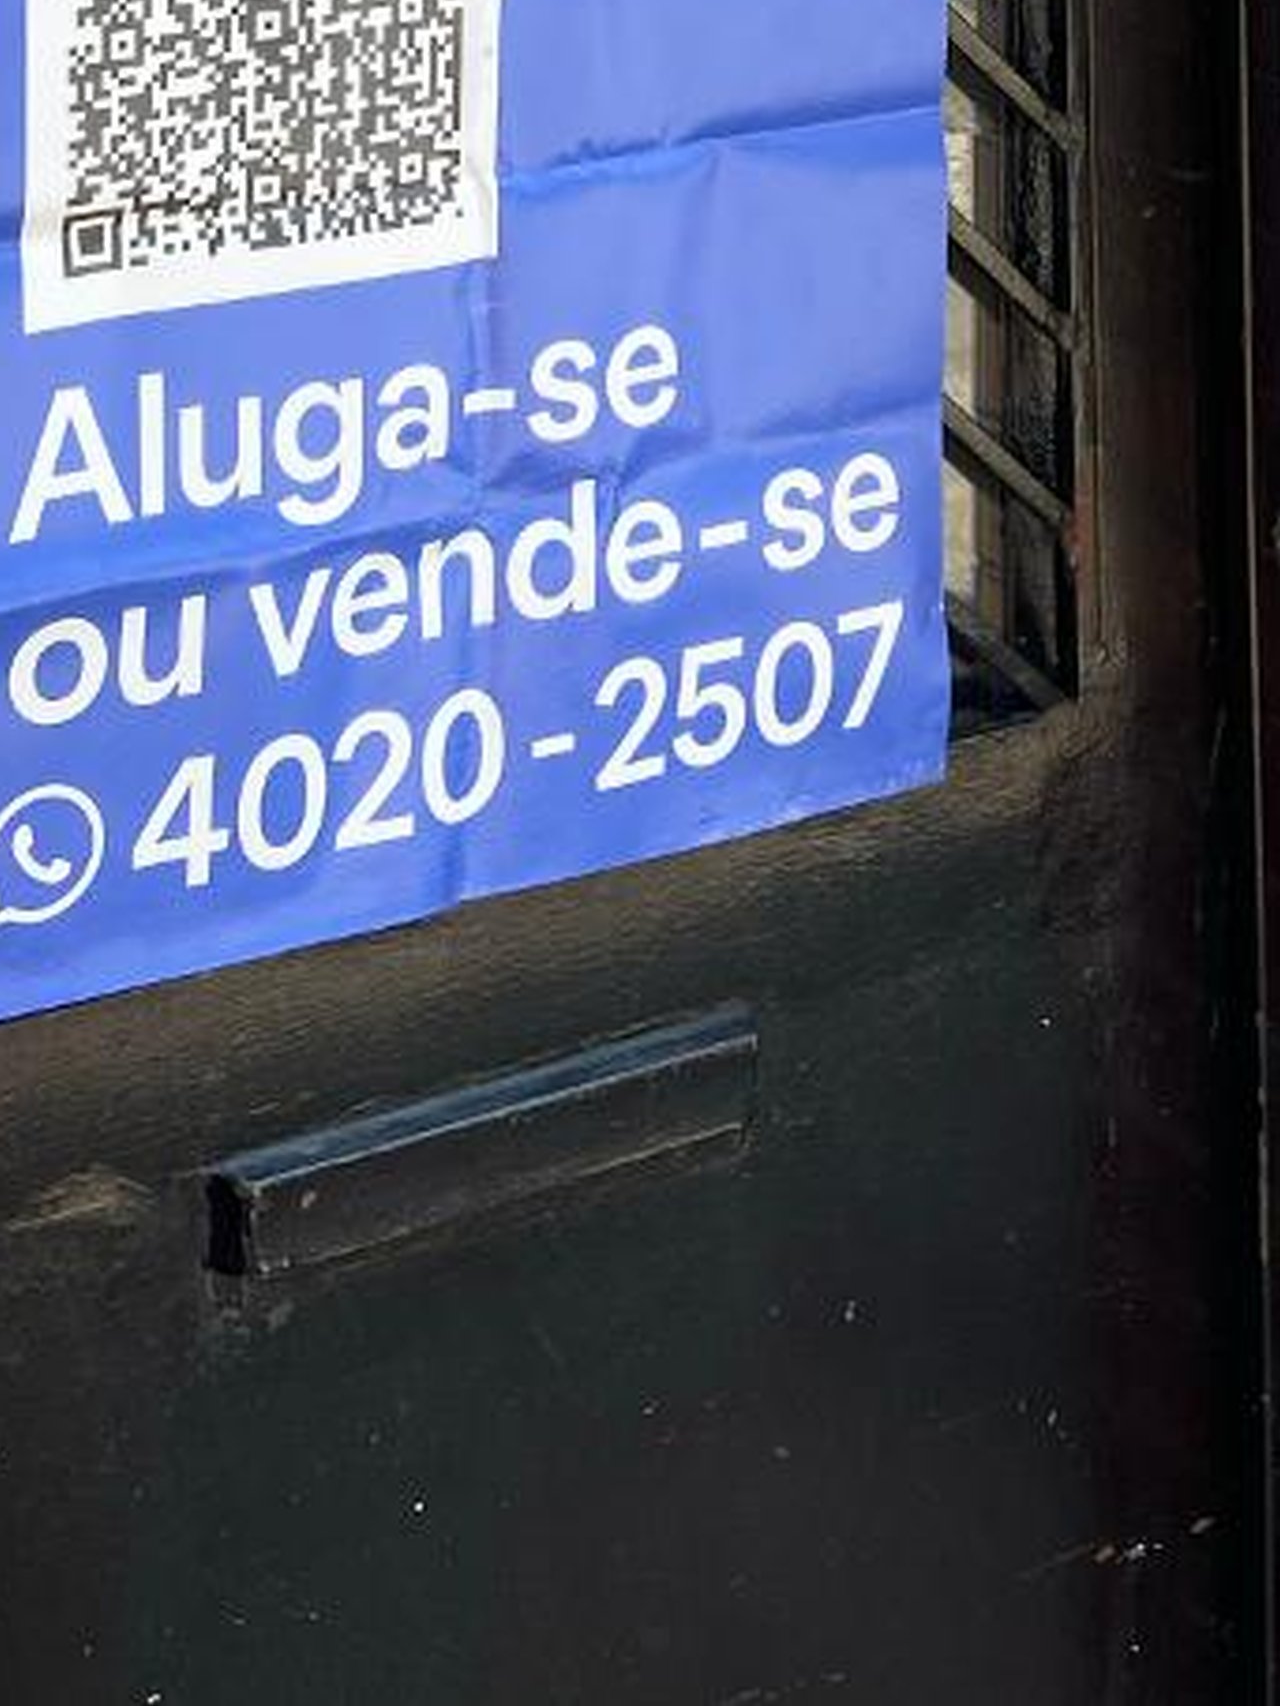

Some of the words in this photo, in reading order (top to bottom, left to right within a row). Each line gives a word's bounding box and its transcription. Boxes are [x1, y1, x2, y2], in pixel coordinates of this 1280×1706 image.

[9, 322, 681, 544] Aluga-se
[8, 595, 208, 726] ou
[249, 451, 902, 678] vende-se
